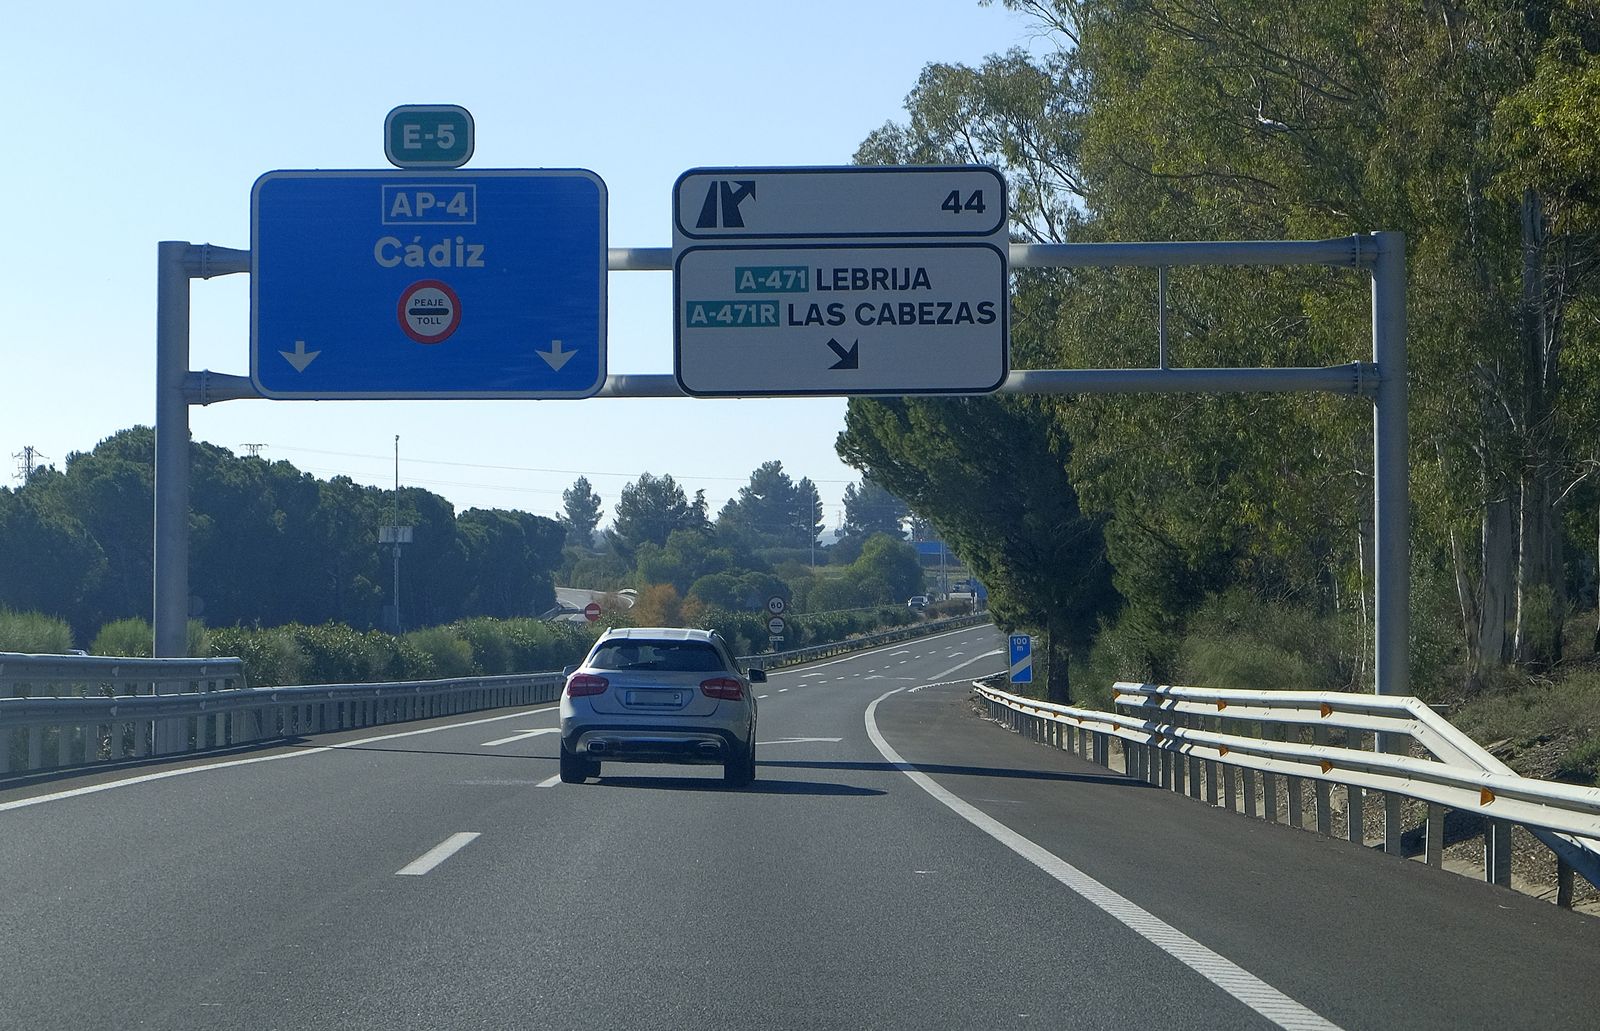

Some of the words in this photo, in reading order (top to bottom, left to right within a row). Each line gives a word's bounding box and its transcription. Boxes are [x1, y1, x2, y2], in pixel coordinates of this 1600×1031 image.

[403, 124, 456, 150] E-5
[390, 191, 469, 218] AP-4
[941, 189, 986, 214] 44
[374, 235, 485, 268] Cádiz
[739, 270, 806, 290] A-471
[816, 267, 932, 291] LEBRIJA
[414, 298, 444, 307] PEAJE
[690, 303, 777, 325] A-471R
[788, 302, 846, 327] LAS
[854, 300, 997, 327] CABEZAS
[417, 317, 442, 325] TOLL
[770, 601, 783, 610] 60
[1013, 637, 1028, 645] 100
